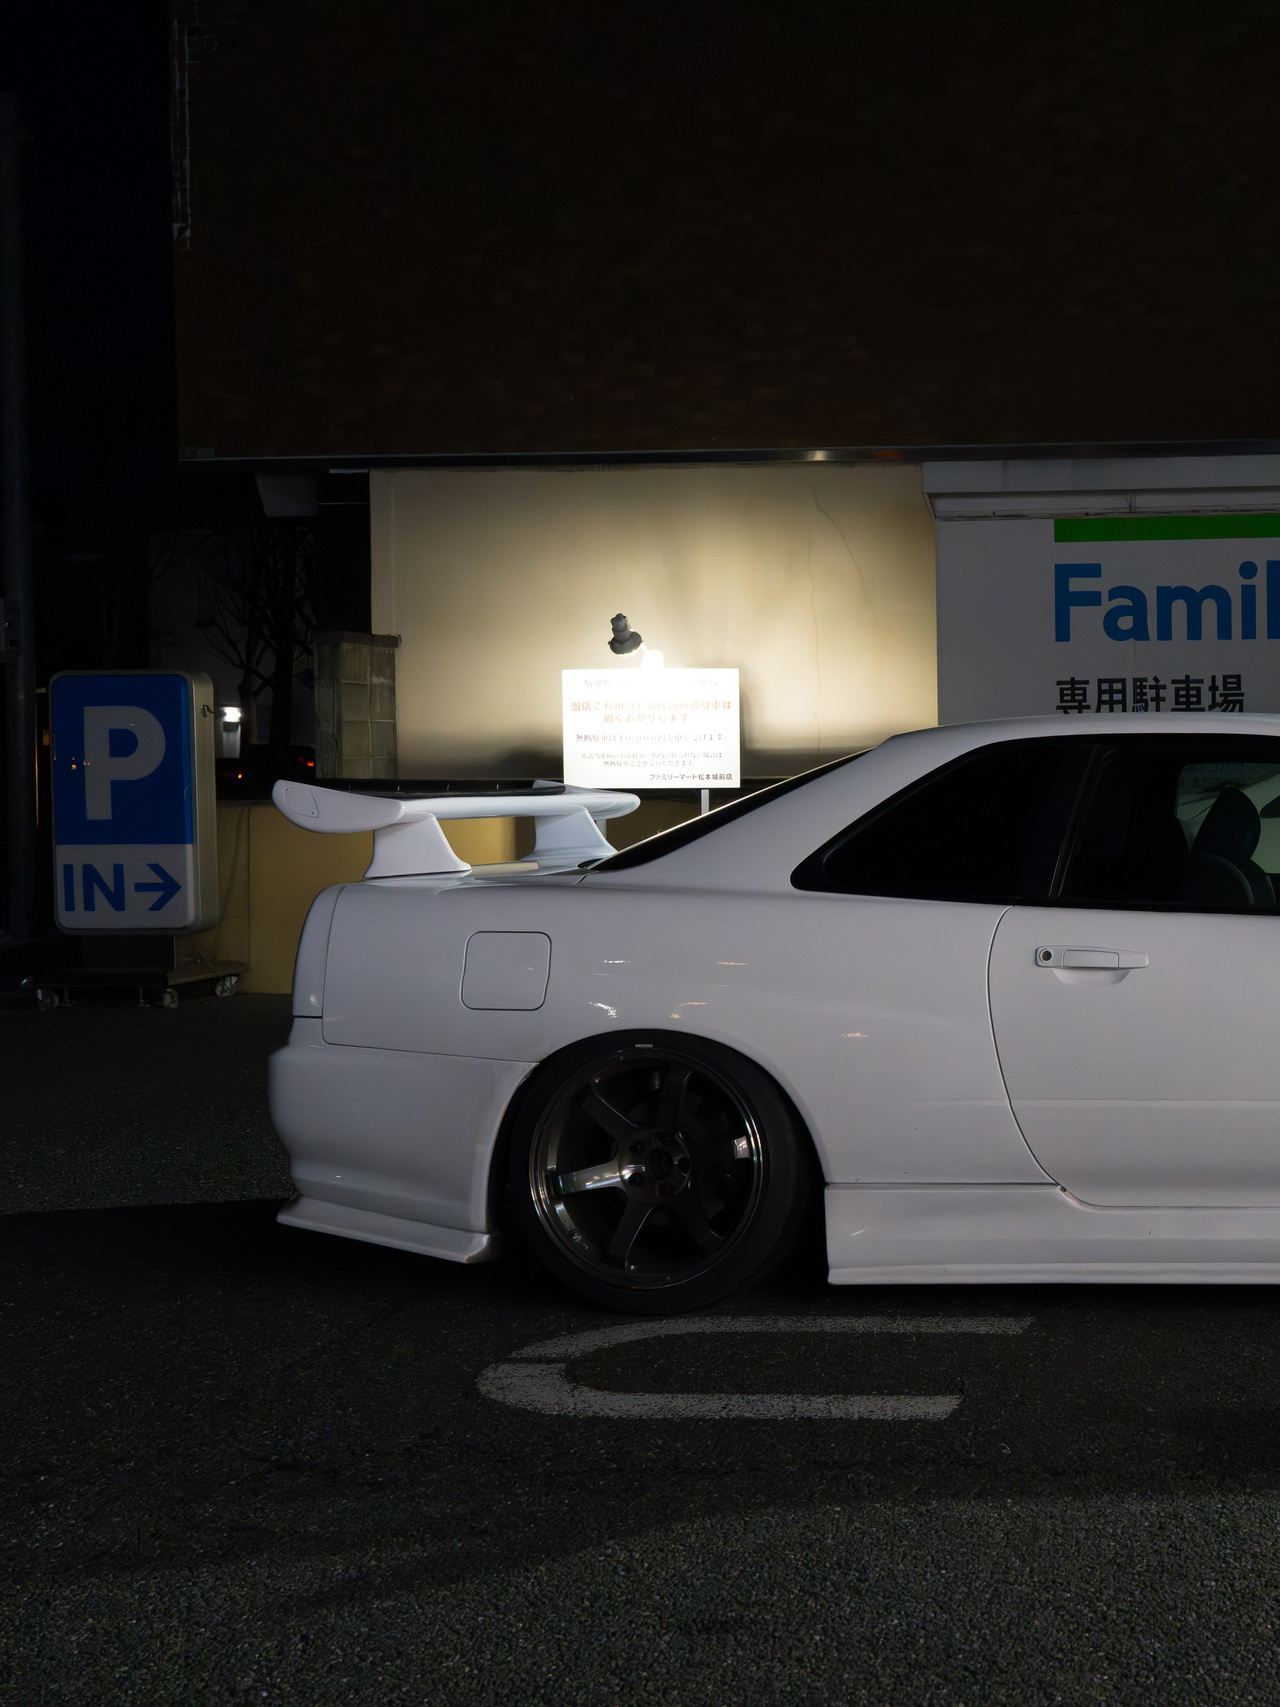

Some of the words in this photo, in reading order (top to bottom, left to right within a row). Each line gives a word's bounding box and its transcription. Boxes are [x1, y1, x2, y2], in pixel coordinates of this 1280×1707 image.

[1055, 674, 1245, 714] 専用駐車場
[83, 705, 166, 820] P
[63, 863, 126, 912] IN
